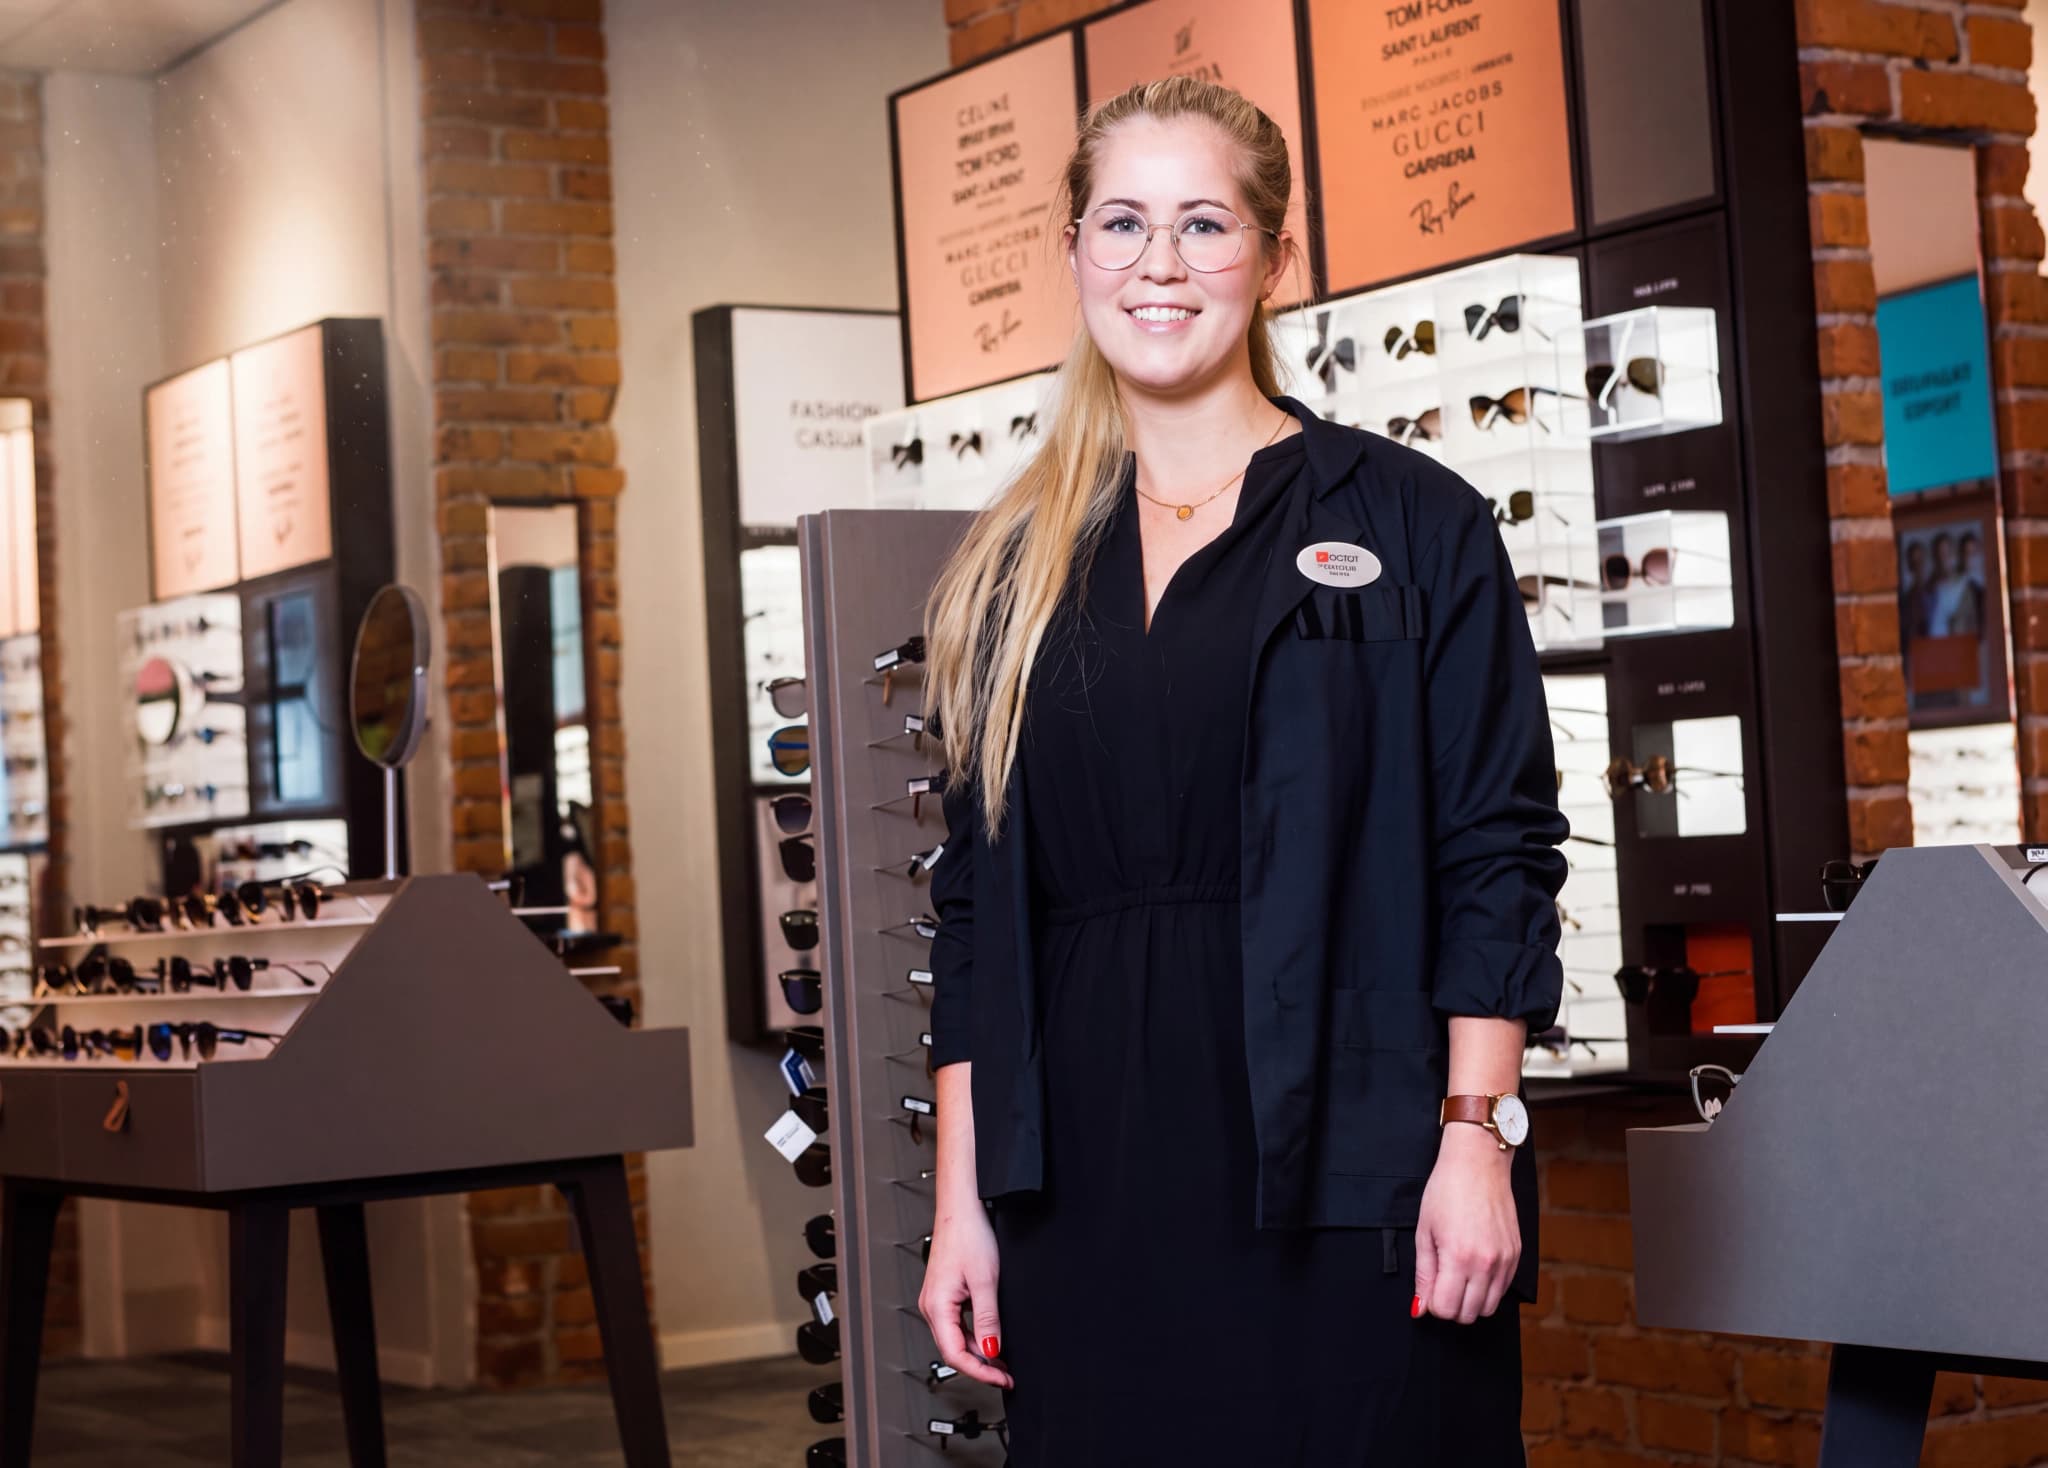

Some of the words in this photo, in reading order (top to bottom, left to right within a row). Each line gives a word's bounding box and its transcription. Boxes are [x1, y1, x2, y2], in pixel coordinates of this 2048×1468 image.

[1385, 0, 1422, 30] TOM
[1427, 0, 1473, 16] FO
[1381, 35, 1416, 61] SAINT
[1420, 13, 1482, 48] LAURENT
[1372, 104, 1421, 133] MARC
[1428, 80, 1504, 116] JACOBS
[1392, 109, 1484, 157] GUCCI
[1403, 144, 1476, 179] CARRERA
[960, 248, 1030, 289] GUCCI
[795, 427, 863, 449] CASUA
